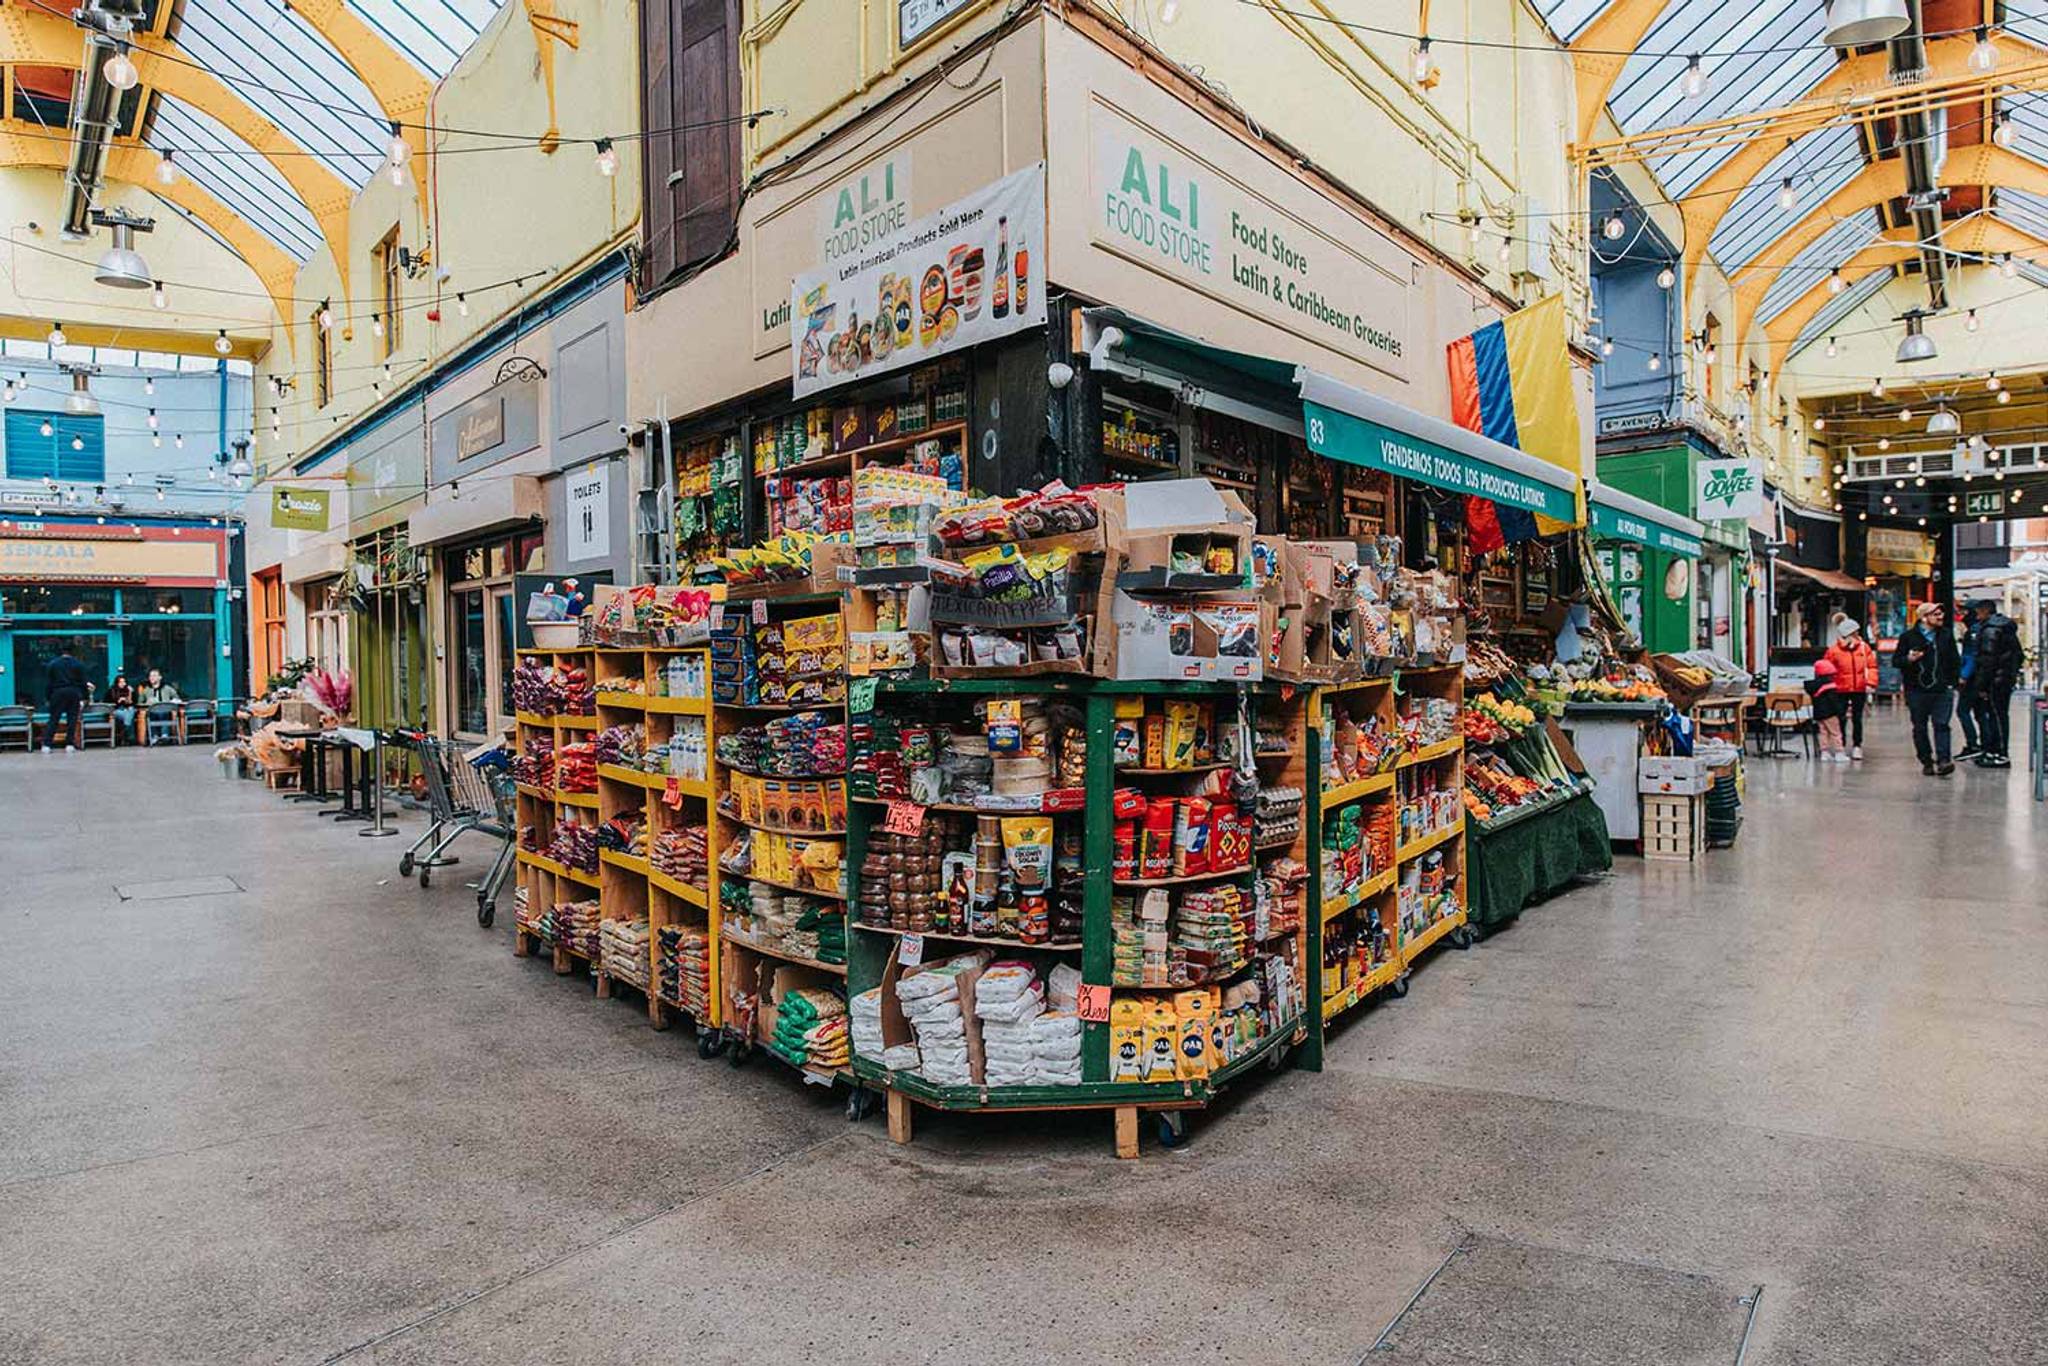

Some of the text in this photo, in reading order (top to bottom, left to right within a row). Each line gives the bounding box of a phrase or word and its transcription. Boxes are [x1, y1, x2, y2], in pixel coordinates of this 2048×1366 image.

[834, 162, 894, 229] ALI
[1121, 147, 1198, 230] ALI
[825, 201, 906, 262] FOOD STORE
[839, 208, 984, 282] Latin American Products Sold Here
[1107, 193, 1211, 274] FOOD STORE
[1231, 211, 1308, 275] Food Store
[1233, 253, 1402, 357] Latin & Caribbean Groceries
[1309, 418, 1325, 445] 83
[1621, 415, 1657, 428] AVENU
[573, 481, 601, 500] TOILETS
[1381, 439, 1546, 508] VENDEMOS TODOS LOS PRODUCTOS LATINOS
[4, 543, 95, 558] SENZALA
[1183, 1039, 1203, 1050] PAN
